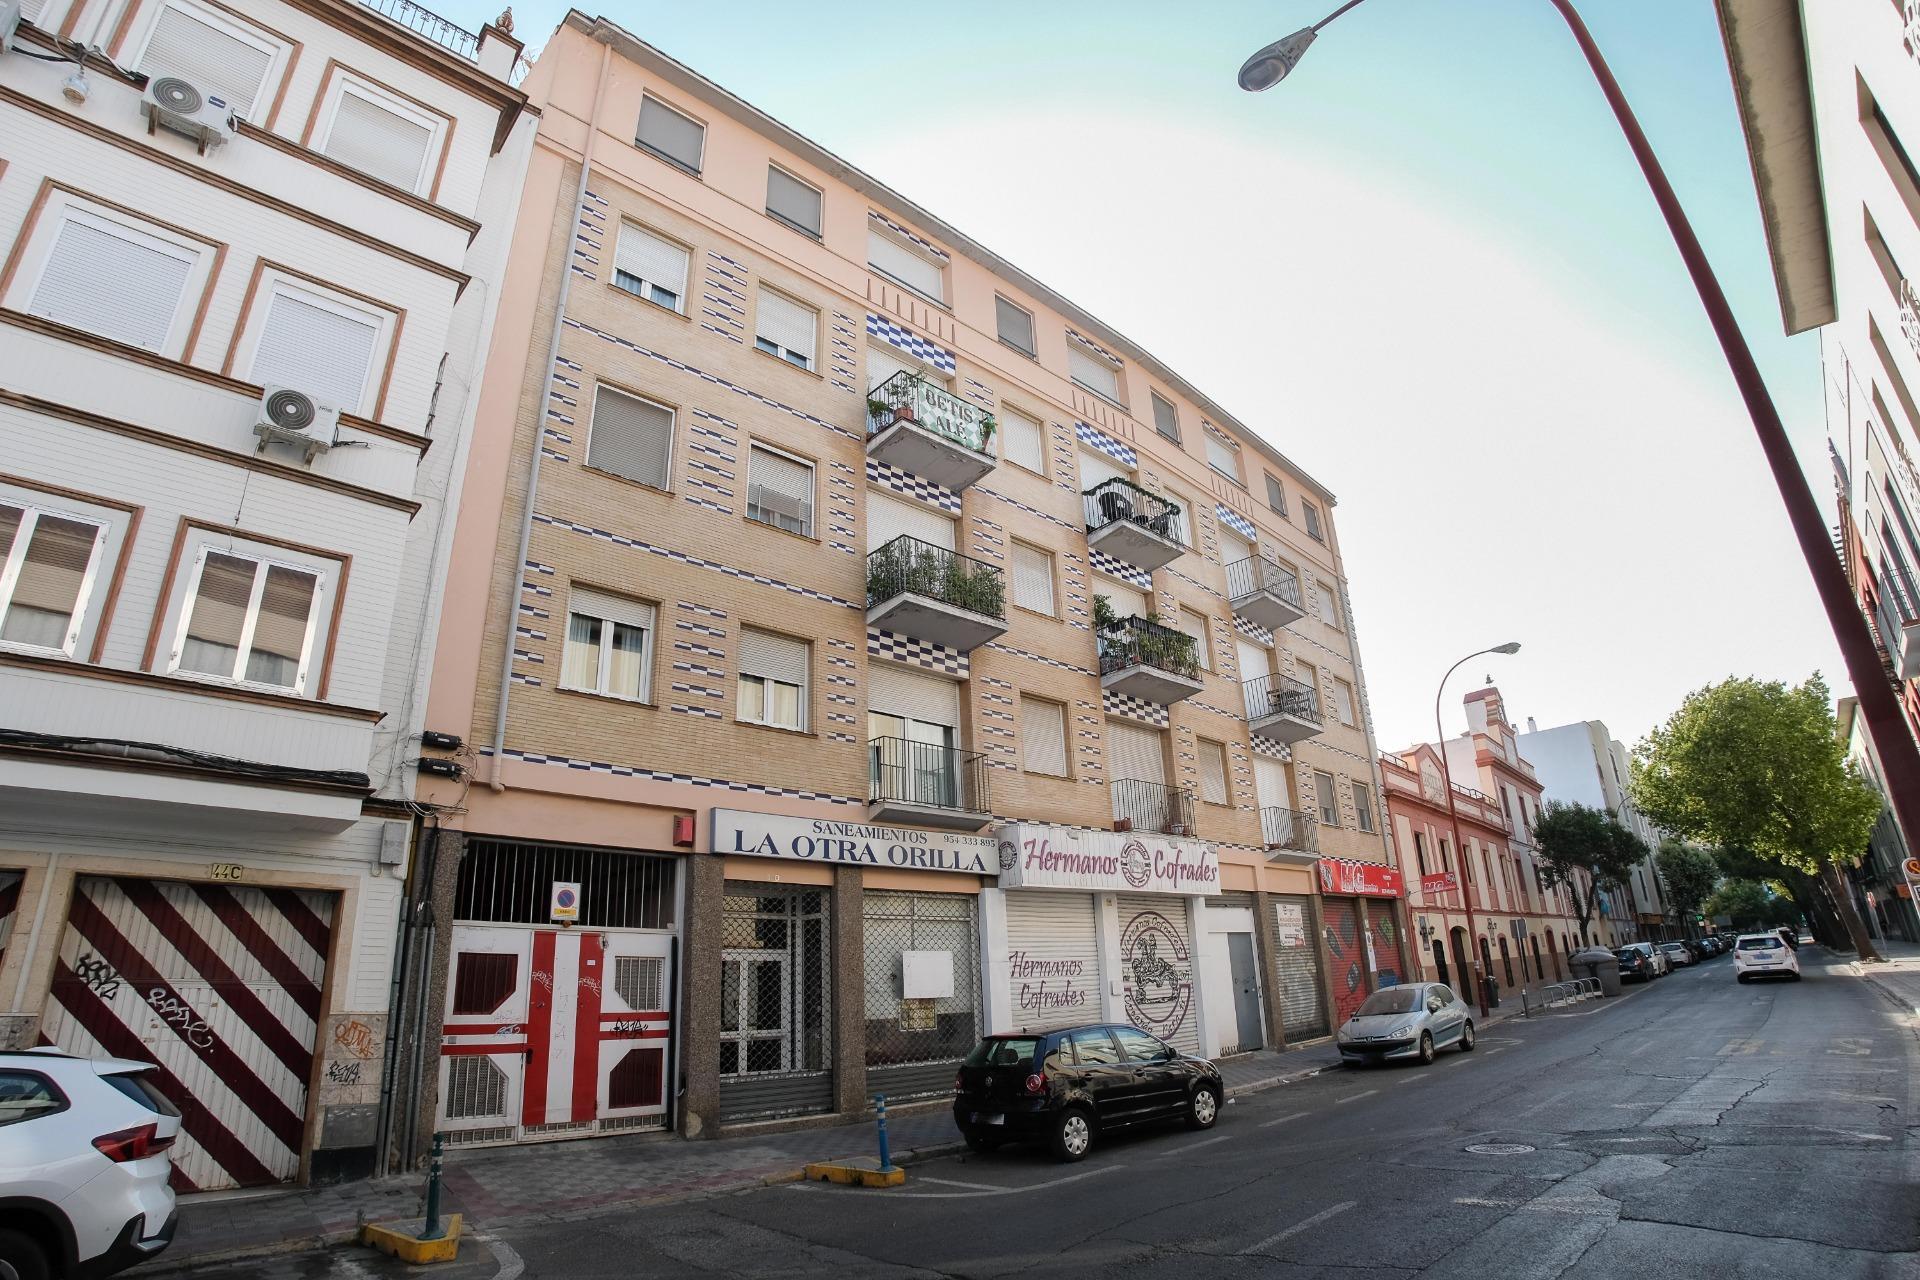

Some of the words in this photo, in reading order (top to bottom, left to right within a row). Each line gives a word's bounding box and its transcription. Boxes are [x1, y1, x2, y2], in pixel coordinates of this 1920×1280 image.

[925, 388, 974, 424] BETIS
[734, 829, 781, 856] LA
[791, 834, 879, 864] OTRA
[887, 844, 987, 872] ORILLA
[812, 820, 929, 845] SANEAMIENTOS
[943, 834, 960, 844] 954
[962, 836, 979, 846] 333
[980, 838, 996, 848] 895
[212, 864, 241, 879] 44C
[1024, 838, 1119, 876] Hermanos
[1154, 849, 1218, 889] Cofrades
[1008, 950, 1083, 978] Hermanos
[1020, 979, 1085, 1018] Cofrades
